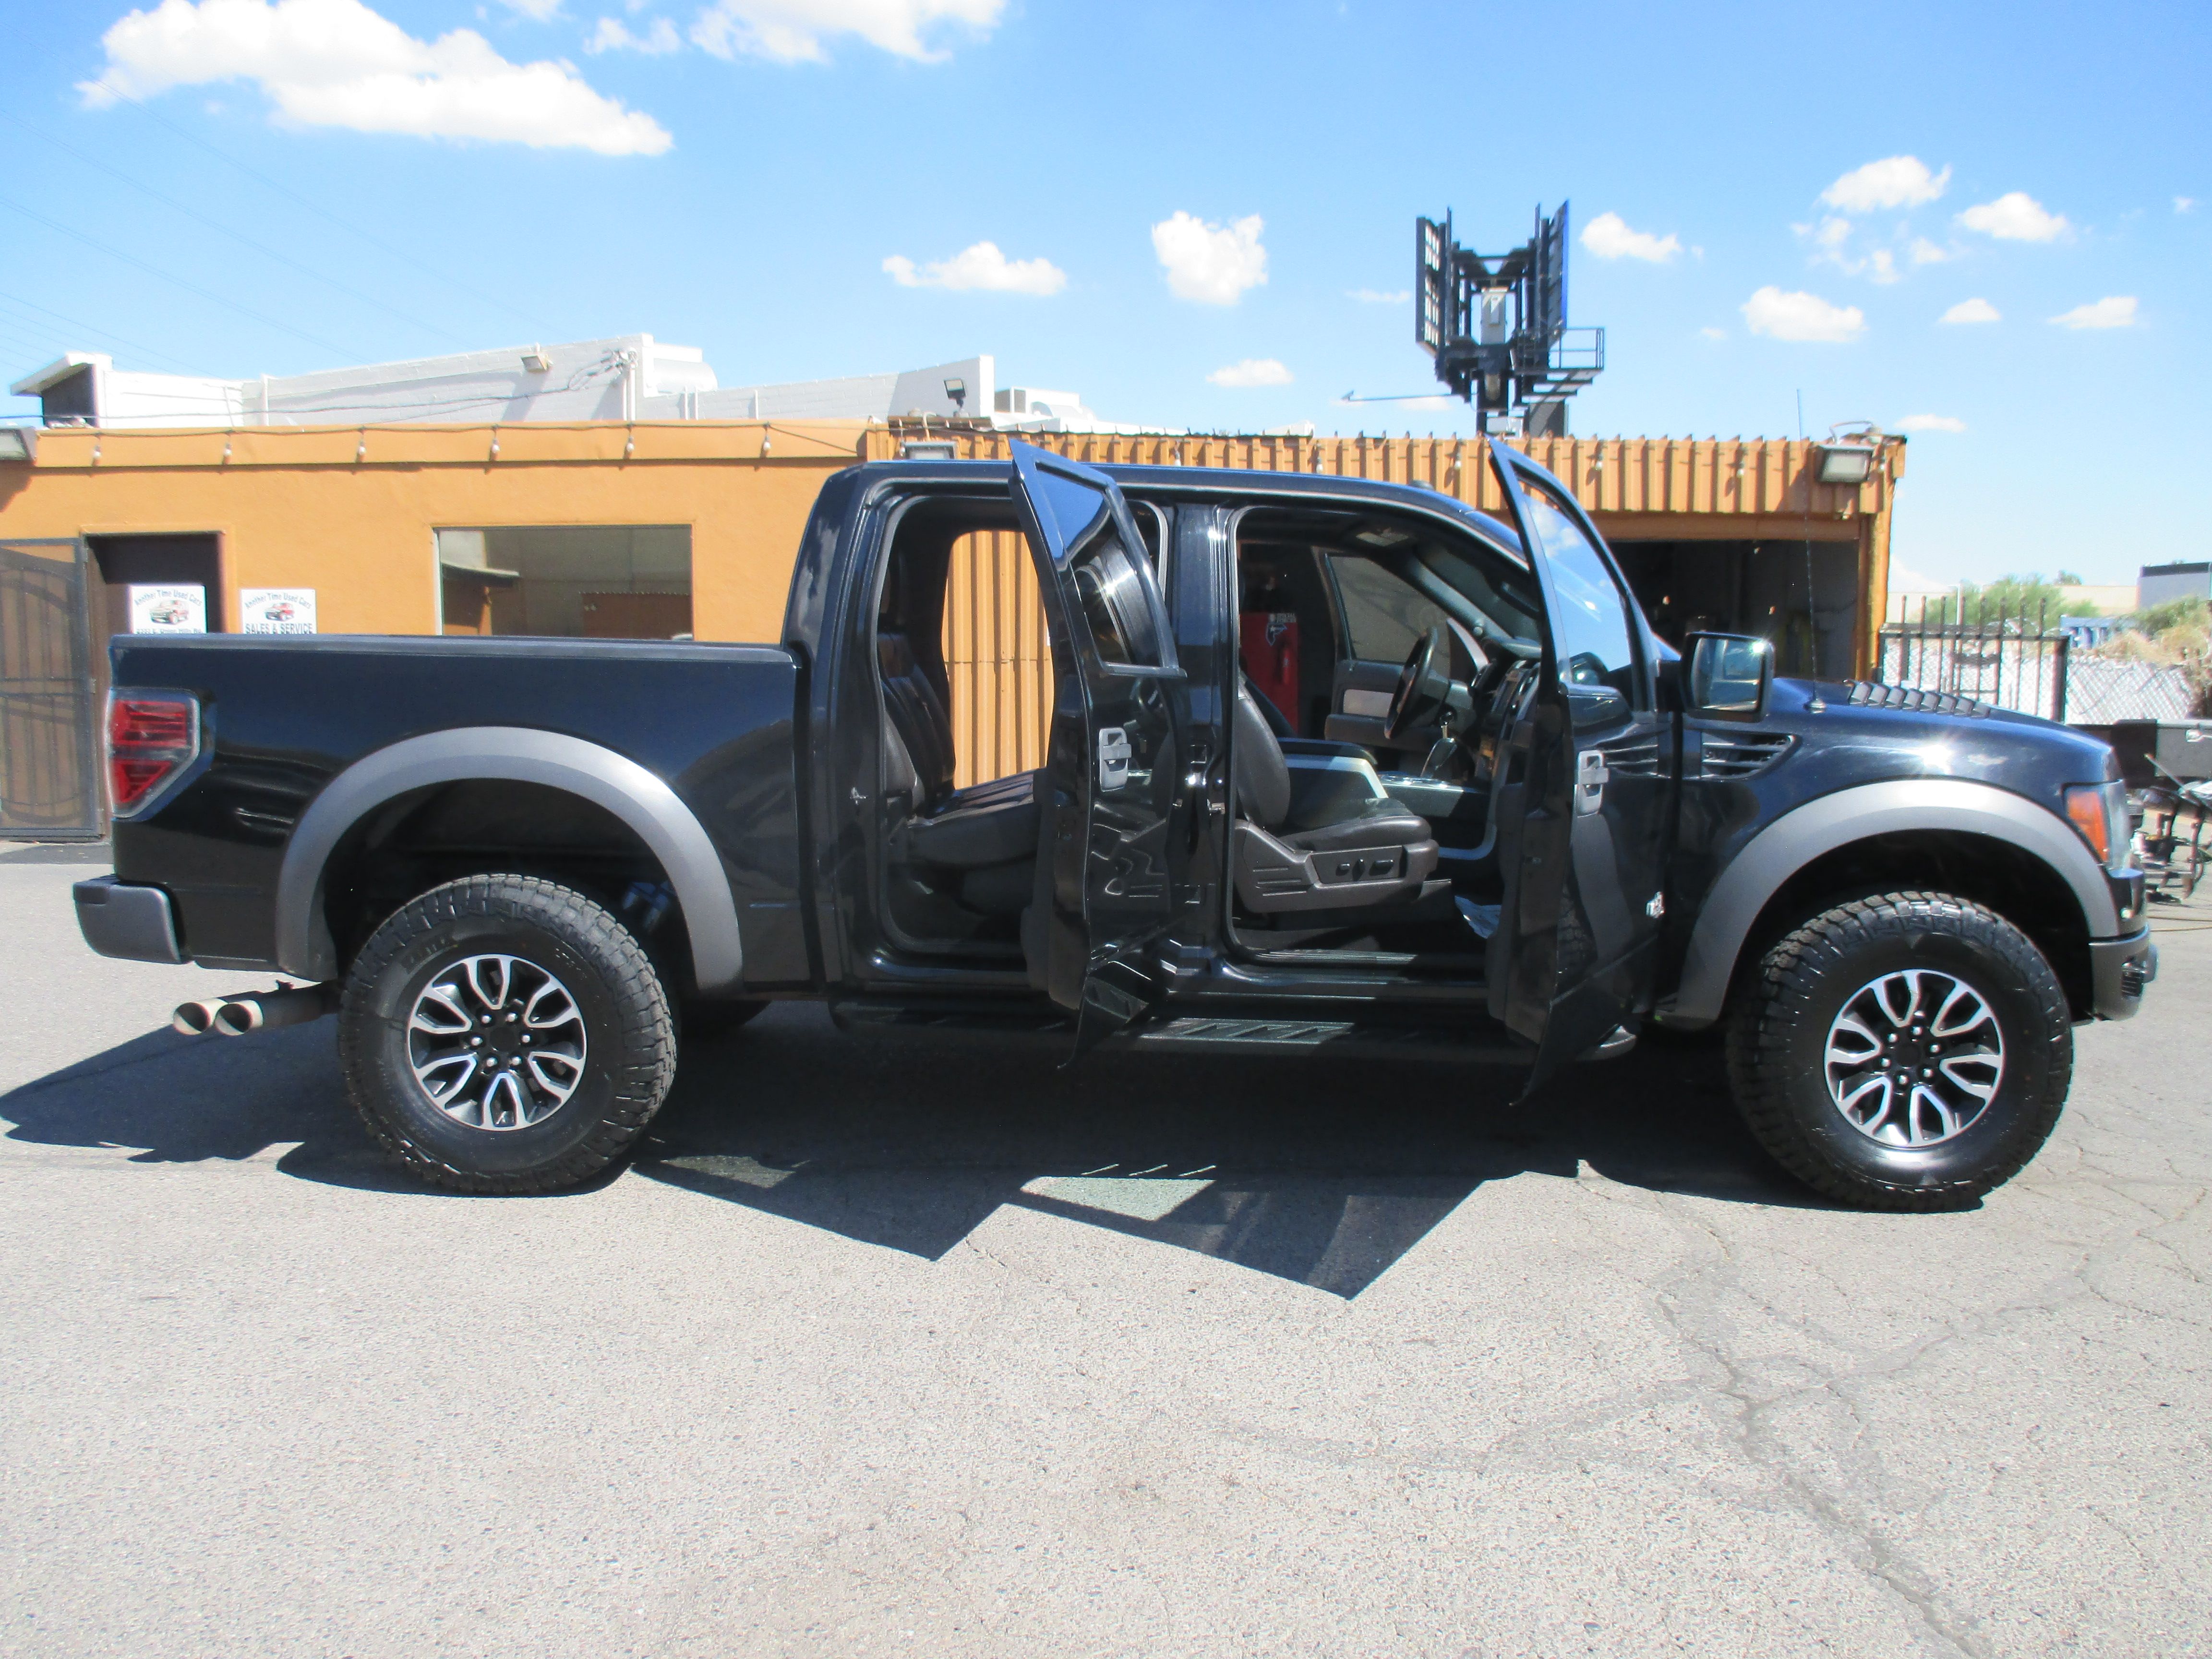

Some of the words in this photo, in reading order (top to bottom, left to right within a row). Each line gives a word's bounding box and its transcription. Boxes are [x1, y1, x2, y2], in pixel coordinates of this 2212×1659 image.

[134, 593, 156, 606] Another
[174, 589, 188, 600] Used
[189, 593, 203, 606] Cars
[244, 595, 266, 609] Another
[284, 593, 298, 602] Used
[299, 597, 312, 609] Cars
[245, 623, 270, 634] SALES
[272, 623, 278, 634] &
[280, 623, 313, 634] SERVICE
